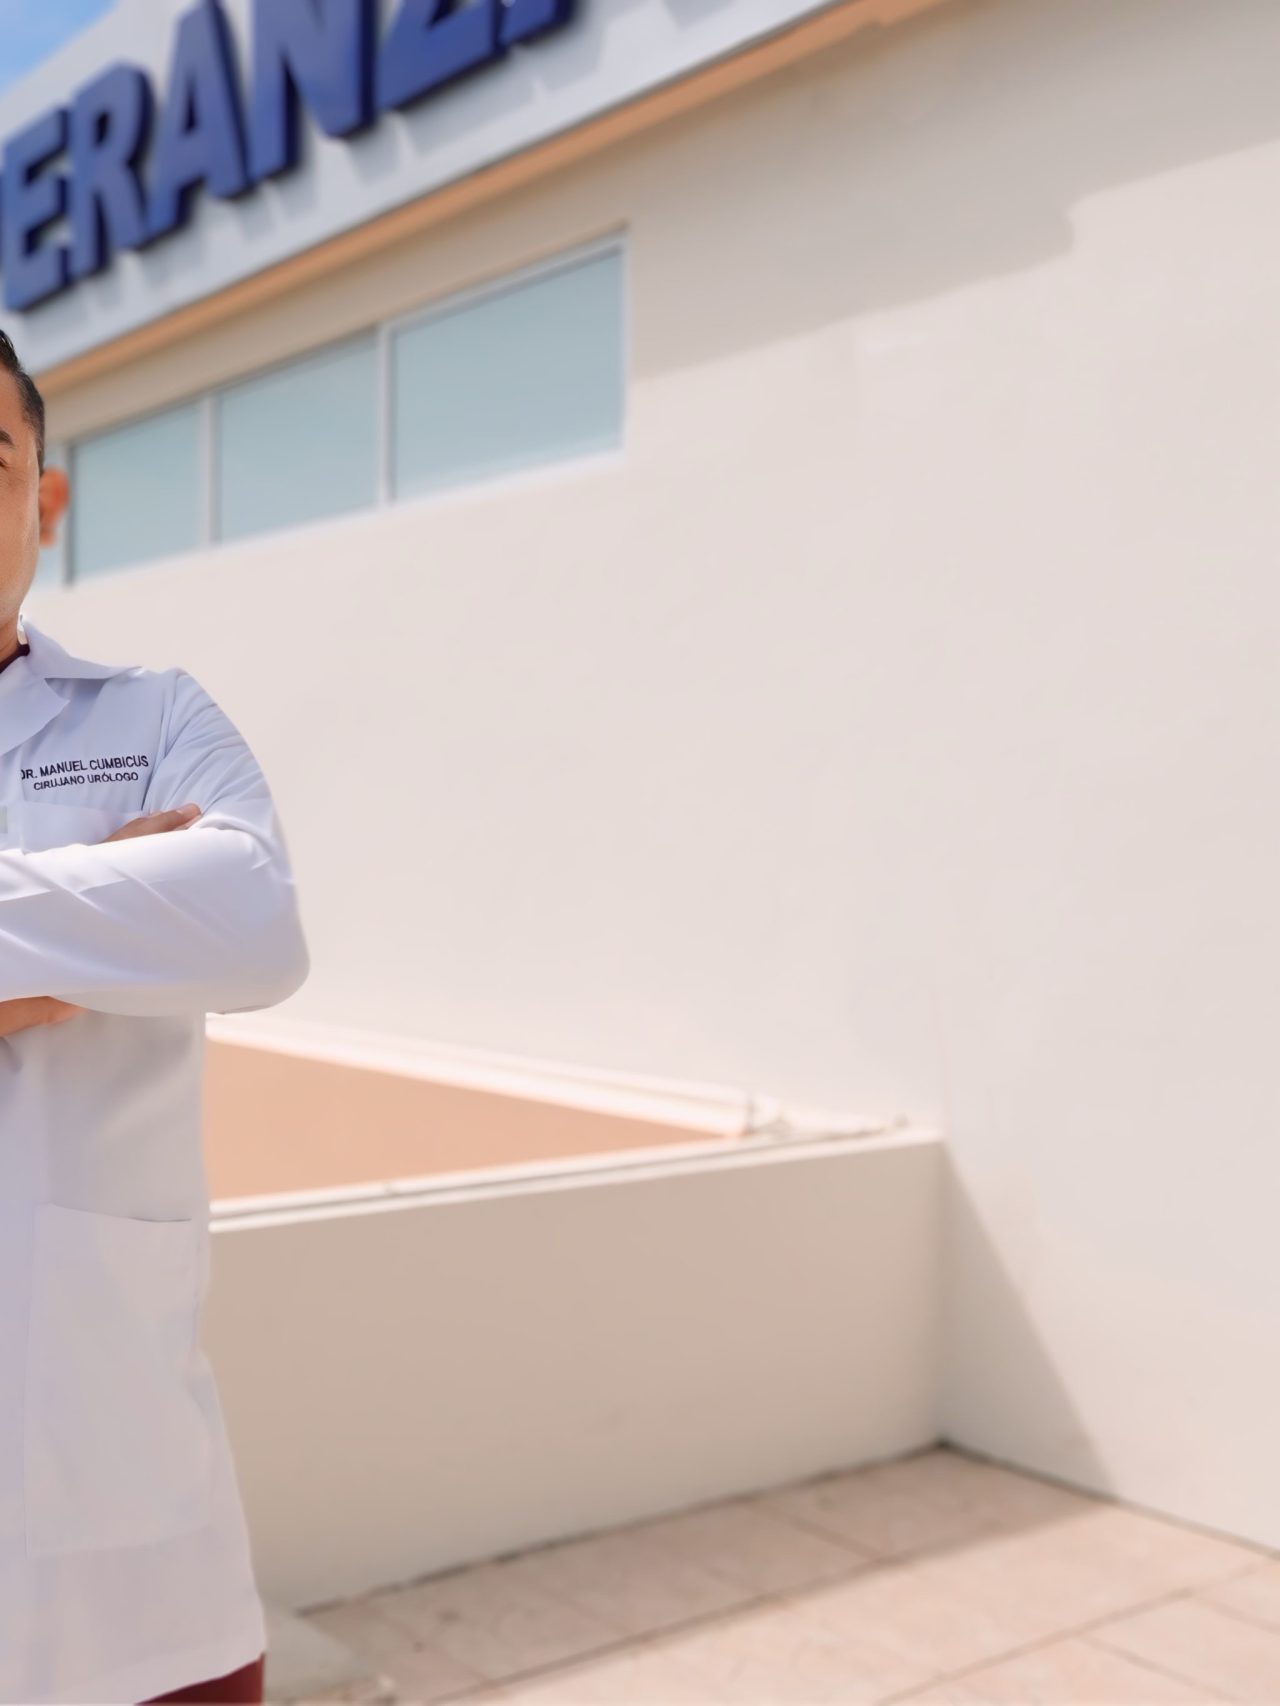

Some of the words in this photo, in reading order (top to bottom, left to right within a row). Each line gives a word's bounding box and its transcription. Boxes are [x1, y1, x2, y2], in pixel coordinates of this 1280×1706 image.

[39, 759, 88, 777] MANUEL
[89, 755, 149, 771] CUMBICUS
[33, 774, 86, 791] CIRUJANO
[86, 771, 139, 784] URÓLOGO
